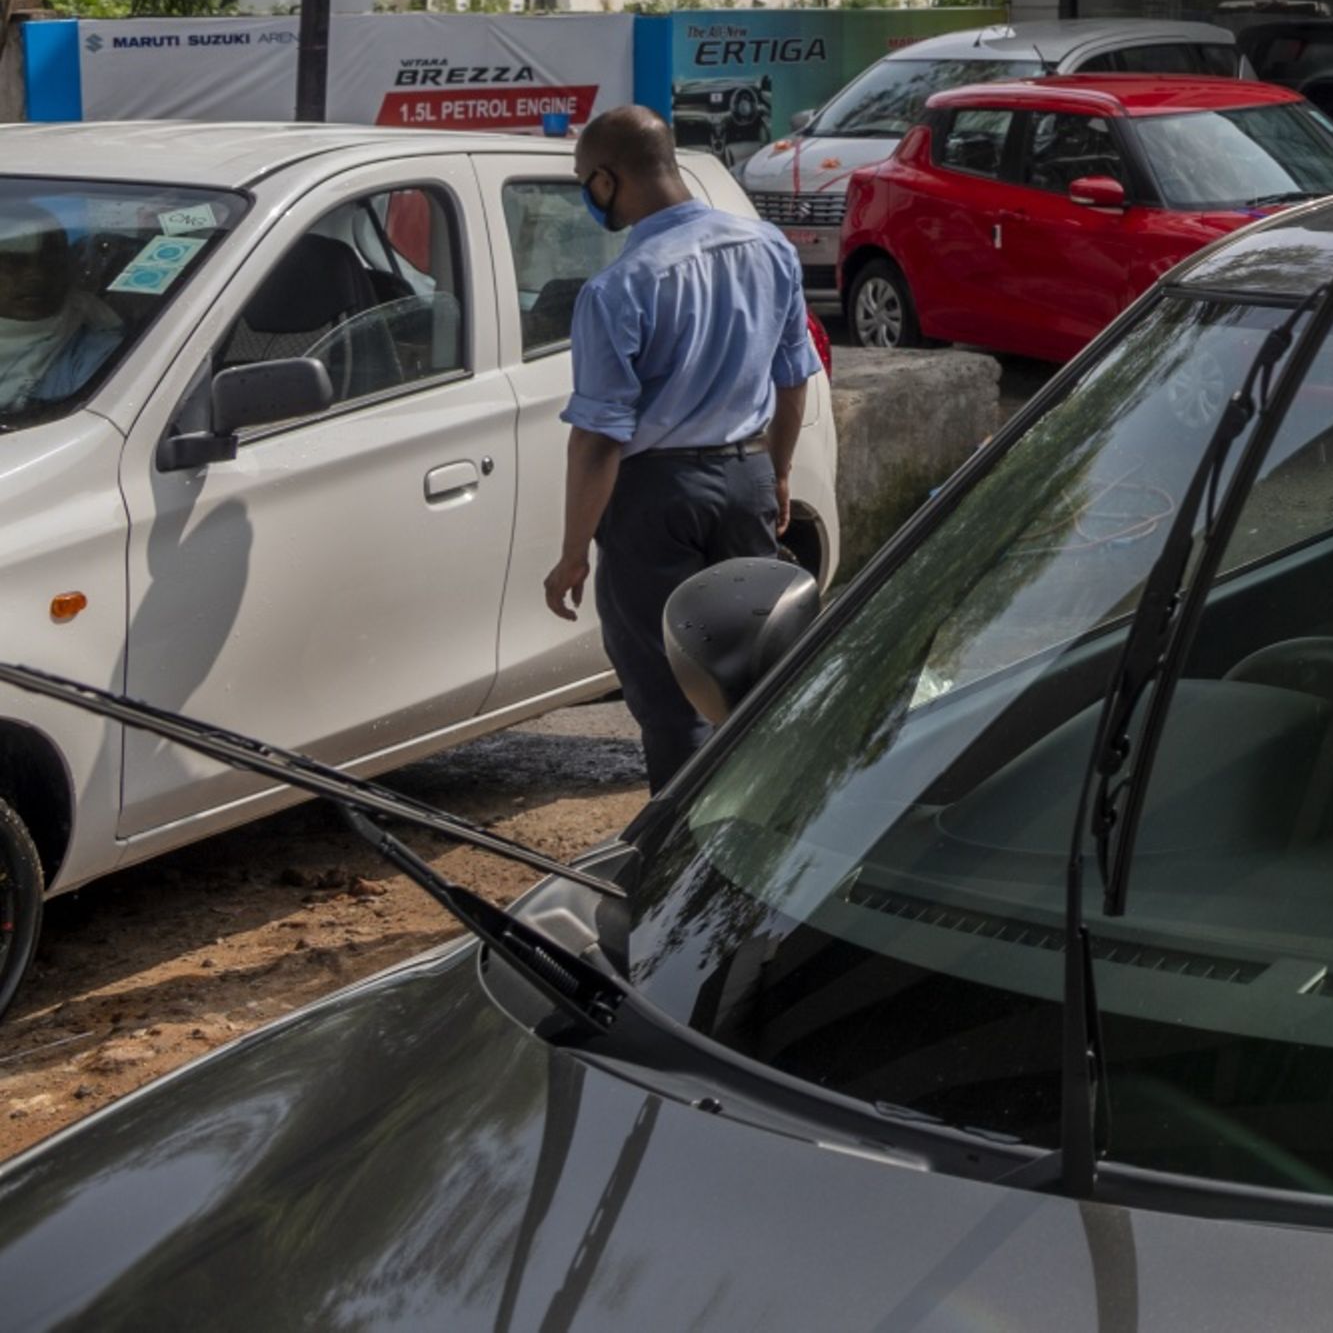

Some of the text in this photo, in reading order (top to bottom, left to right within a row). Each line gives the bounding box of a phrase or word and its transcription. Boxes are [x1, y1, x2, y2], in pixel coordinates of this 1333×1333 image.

[112, 31, 300, 48] MARUTI SUZUKI AREN
[687, 25, 748, 38] The All-New
[694, 38, 828, 66] ERTIGA
[400, 58, 449, 67] VITARA
[394, 66, 534, 86] BREZZA
[398, 96, 578, 122] 1.5L PETROL ENGINE
